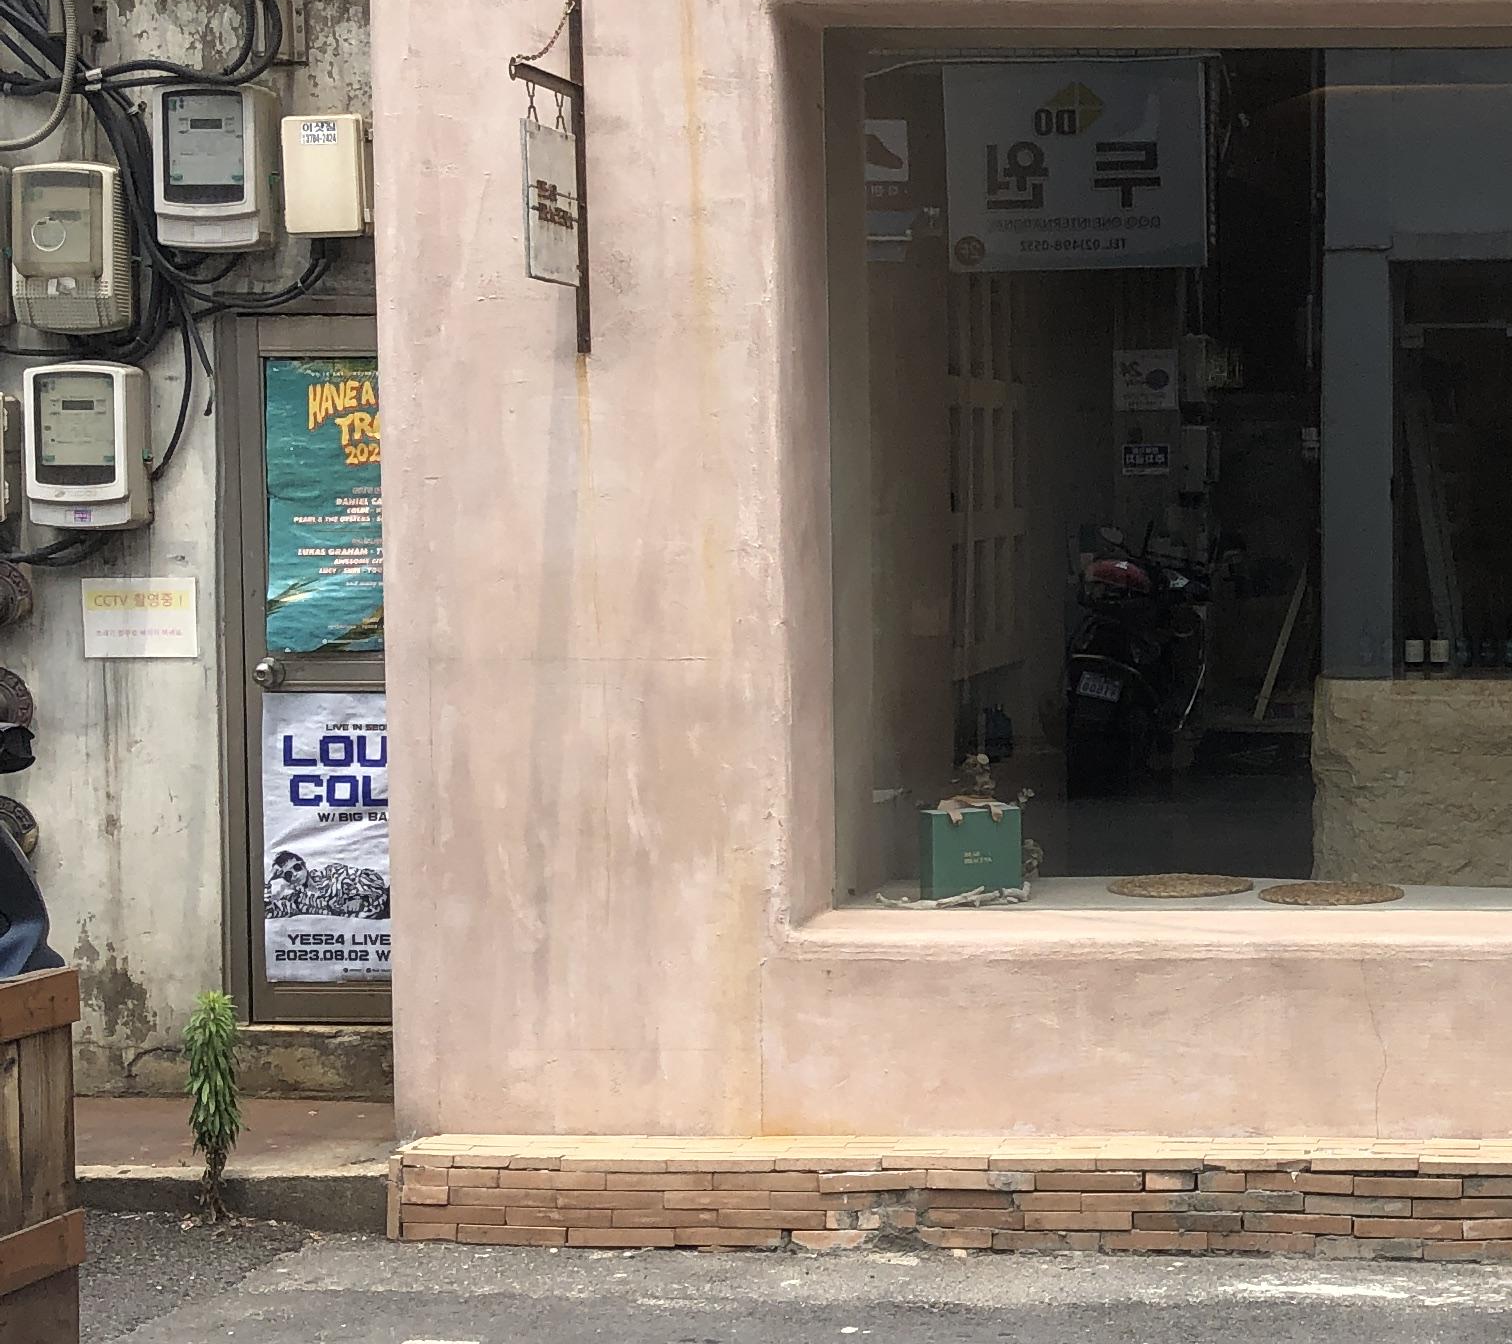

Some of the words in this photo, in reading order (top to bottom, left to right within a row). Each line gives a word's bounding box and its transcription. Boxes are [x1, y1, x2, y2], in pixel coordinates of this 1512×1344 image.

[308, 379, 359, 431] HAVE
[361, 380, 378, 406] A
[297, 548, 326, 556] LUKAS
[327, 547, 368, 556] GRAHAM
[94, 594, 127, 607] CCTV
[325, 723, 349, 731] LIVE
[352, 723, 362, 731] IN
[338, 812, 363, 822] BIG
[287, 933, 345, 946] YES24
[351, 933, 391, 946] LIVE
[274, 949, 370, 962] 2023.08.02
